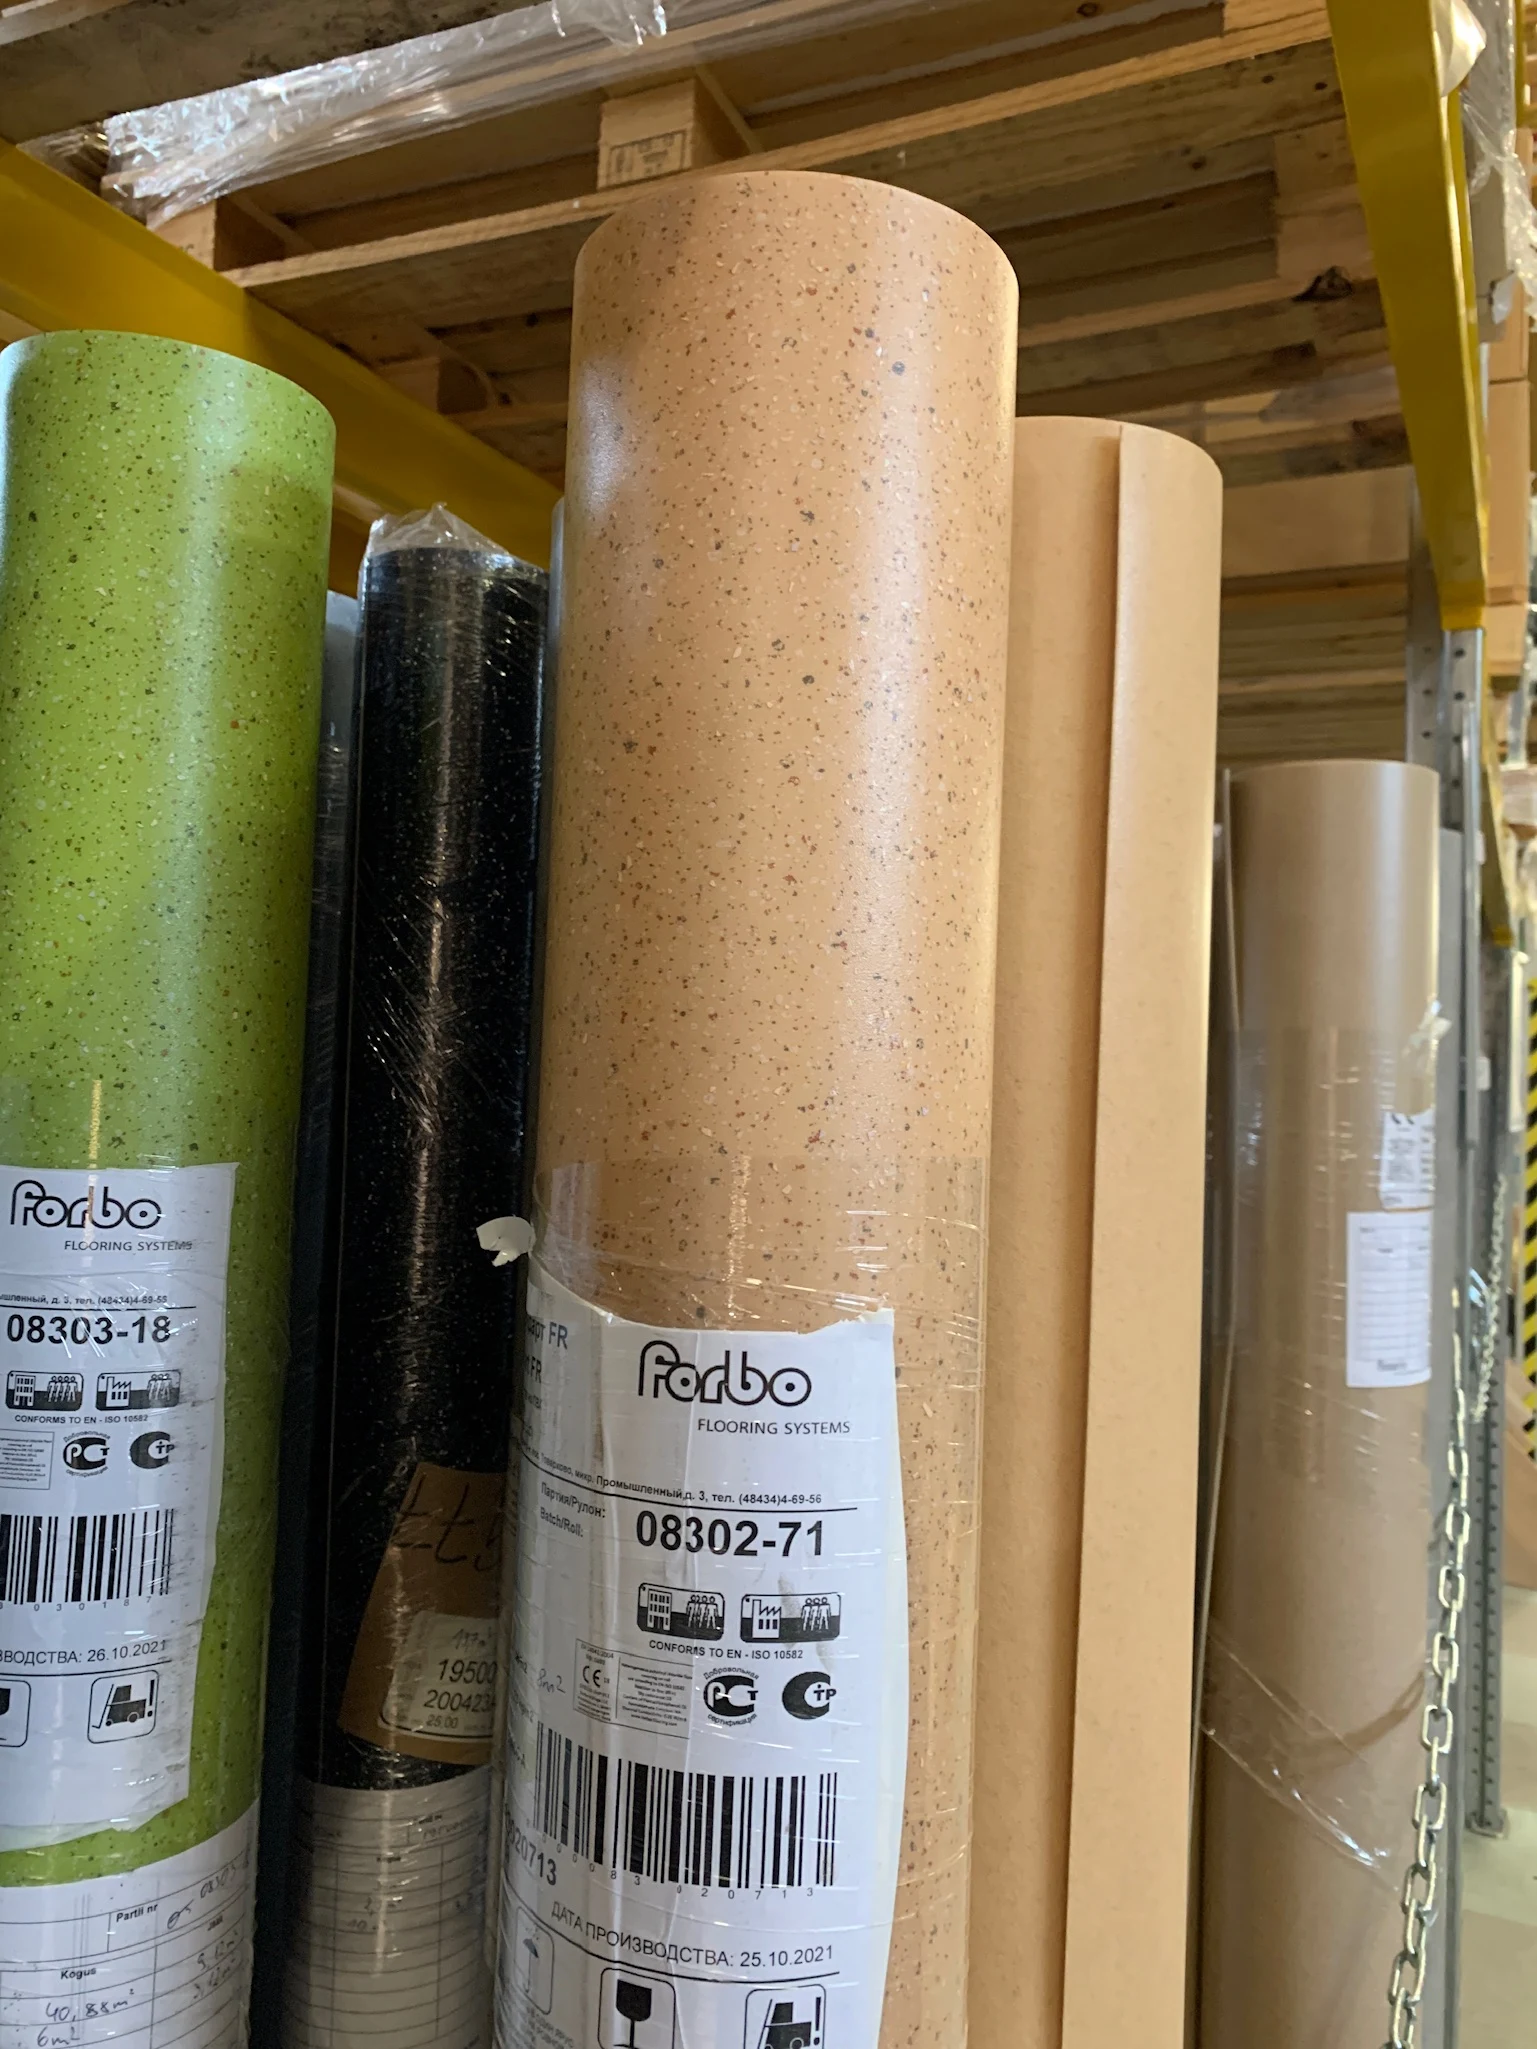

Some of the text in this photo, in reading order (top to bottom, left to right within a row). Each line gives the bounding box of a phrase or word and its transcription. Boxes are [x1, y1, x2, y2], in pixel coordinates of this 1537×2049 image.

[11, 1180, 162, 1229] forbo
[64, 1240, 192, 1252] FLOORING SYSTEMS
[7, 1313, 172, 1345] 08303-18
[549, 1321, 568, 1350] FR
[638, 1340, 812, 1407] forbo
[15, 1414, 66, 1425] CONFORMS
[69, 1416, 80, 1424] TO
[84, 1416, 96, 1424] EN
[105, 1415, 121, 1424] ISO
[124, 1414, 149, 1423] 10582
[697, 1418, 851, 1435] FLOORING SYSTEMS
[698, 1490, 708, 1503] 3,
[712, 1493, 735, 1503] тел.
[739, 1493, 822, 1506] (48434)4-69-56
[540, 1506, 584, 1538] Batch/Roll:
[636, 1510, 823, 1557] 08302-71
[87, 1639, 167, 1662] 26.10.2021
[649, 1639, 705, 1656] CONFORMS
[709, 1647, 723, 1658] TO
[727, 1649, 742, 1659] EN
[751, 1649, 771, 1660] ISO
[774, 1649, 803, 1660] 10582
[116, 1907, 144, 1922] Partii
[147, 1903, 158, 1914] nr
[551, 1901, 833, 1968] ДАТА ПРОИЗВОДСТВА: 25.10.2021
[60, 1967, 97, 1980] Kogus
